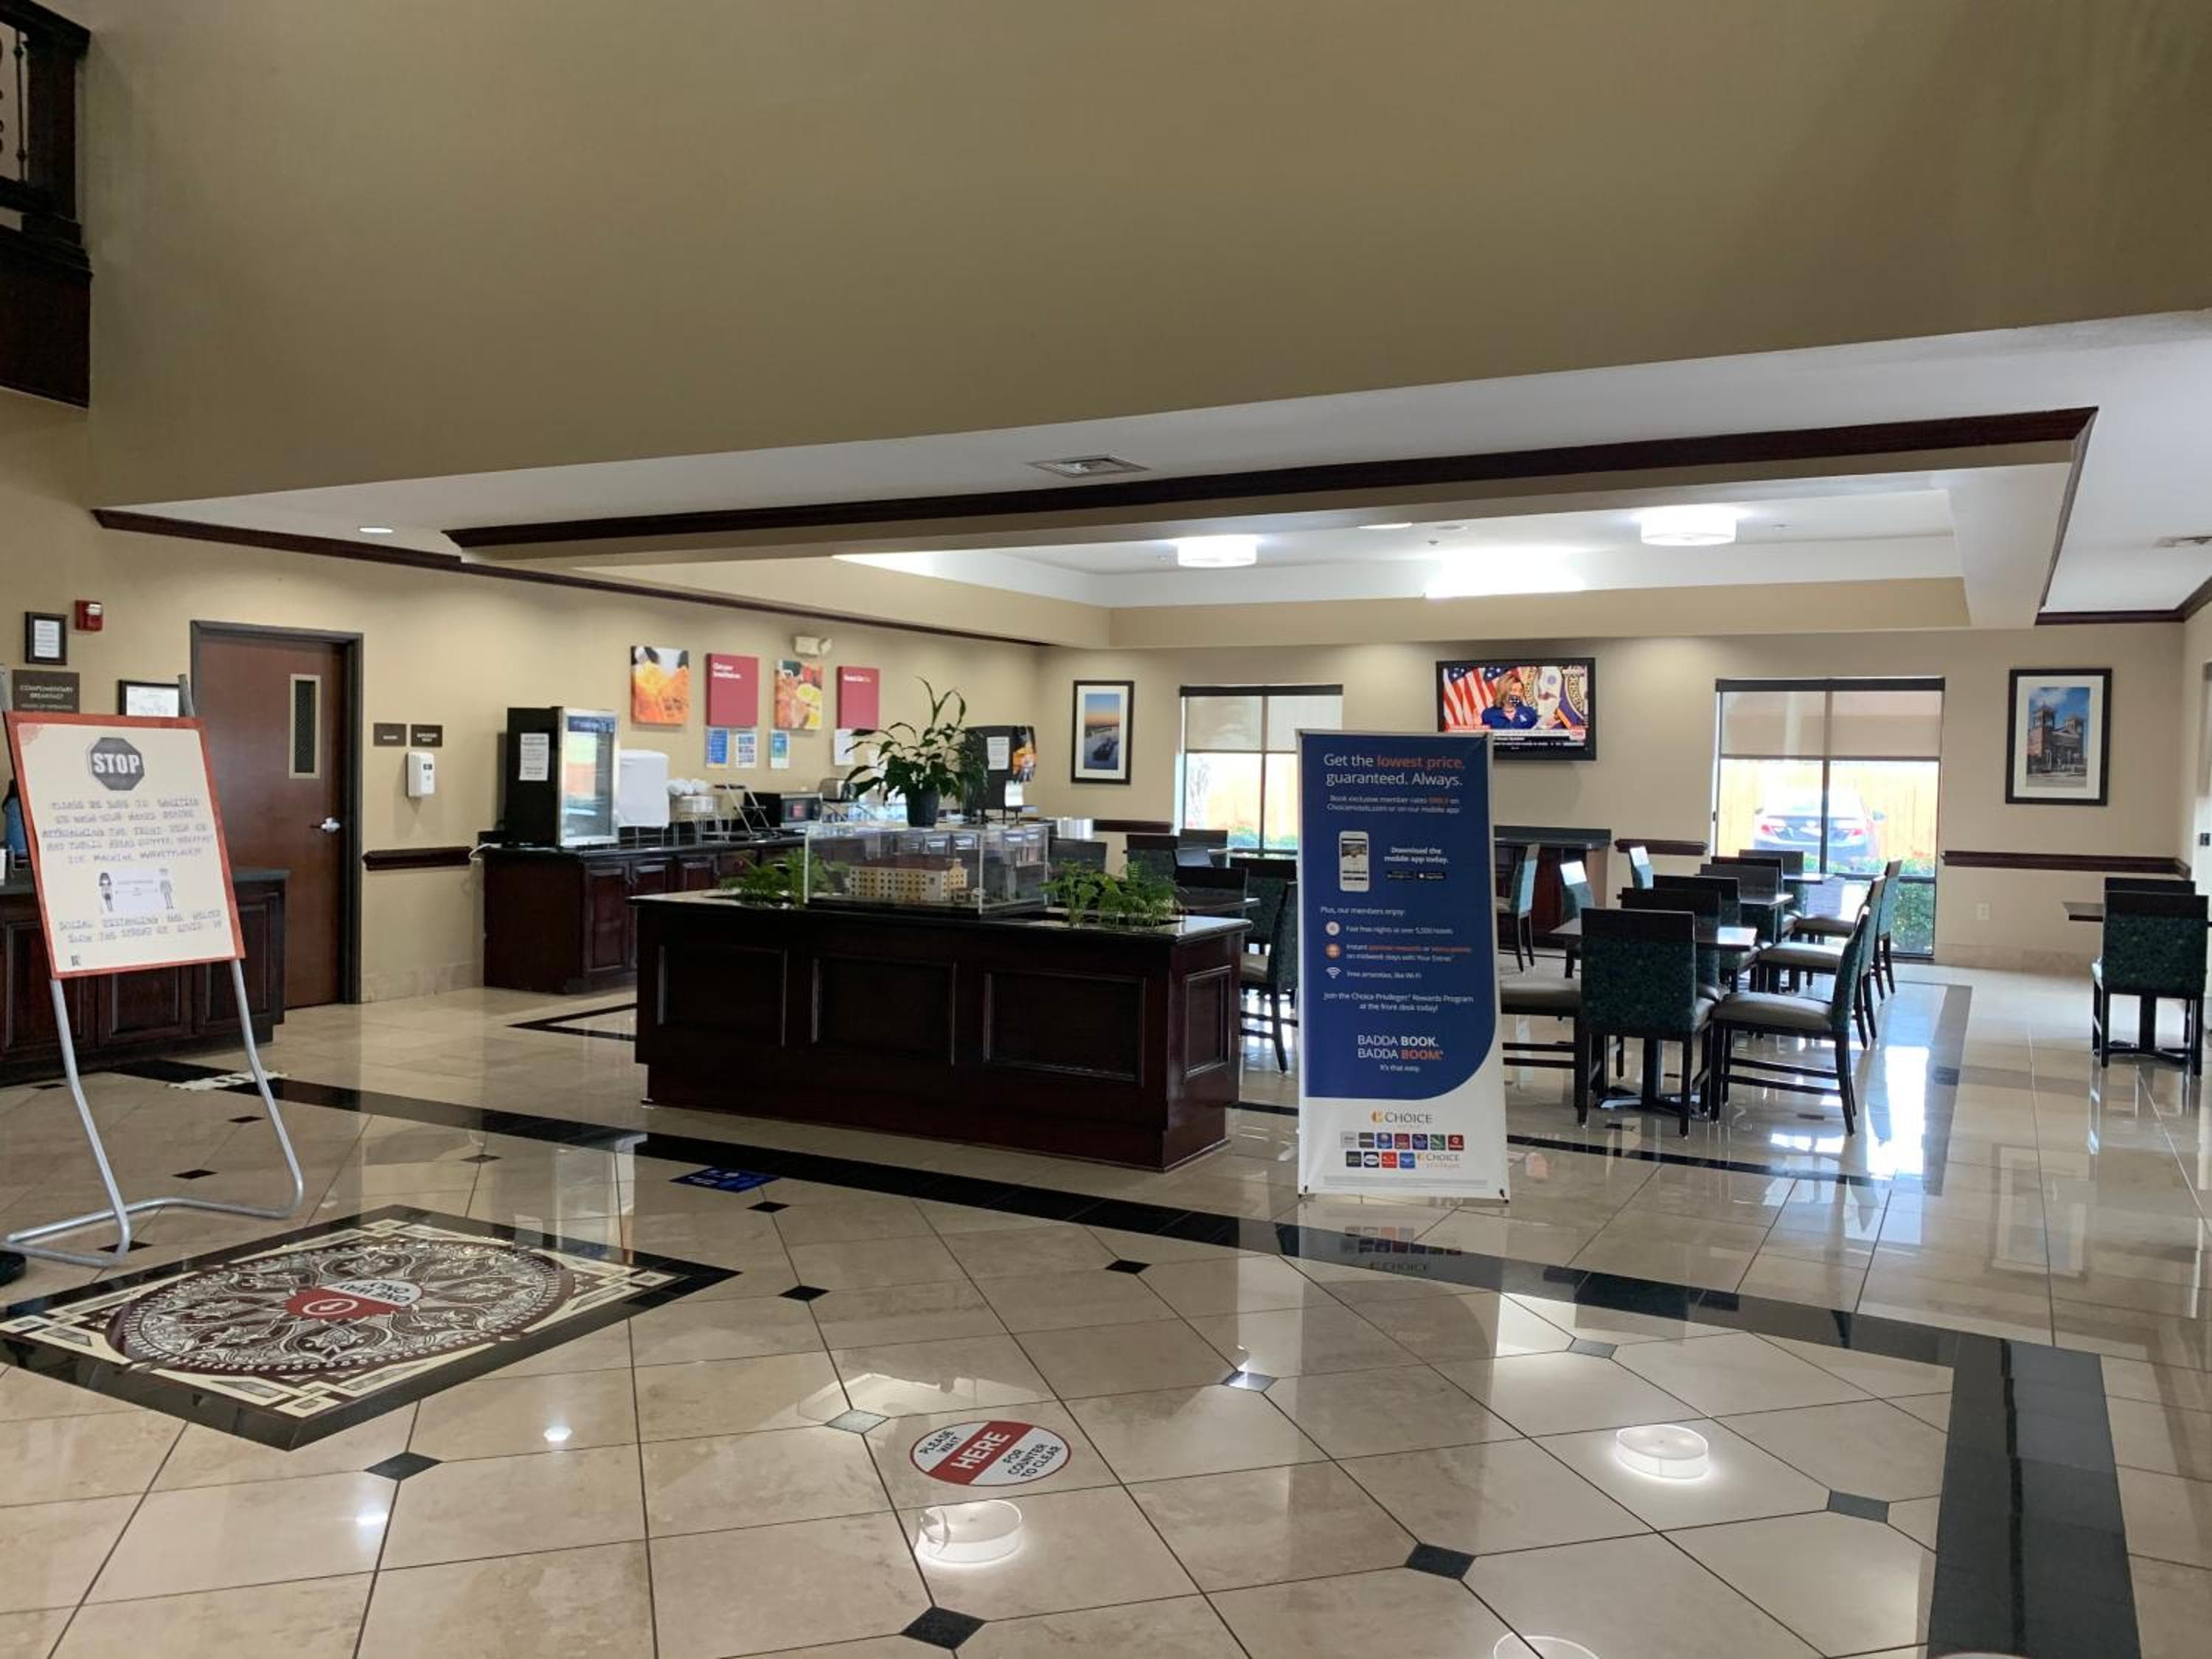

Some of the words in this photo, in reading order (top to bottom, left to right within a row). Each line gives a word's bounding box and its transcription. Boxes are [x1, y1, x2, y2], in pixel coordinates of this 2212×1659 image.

[93, 753, 141, 774] STOP
[1324, 754, 1349, 767] Get
[1352, 755, 1374, 768] the
[1377, 756, 1424, 768] lowest
[1326, 773, 1408, 787] guaranteed.
[1411, 773, 1464, 789] Always.
[1390, 846, 1428, 855] Download
[1429, 846, 1441, 855] the
[1426, 856, 1449, 864] today.
[1321, 906, 1337, 914] Plus,
[1324, 992, 1338, 1001] Join
[1351, 992, 1374, 1001] Choice
[1443, 995, 1474, 1004] Program
[1357, 1034, 1399, 1046] BADDA
[1401, 1036, 1439, 1047] BOOK.
[1357, 1048, 1399, 1060] BADDA
[1385, 1112, 1433, 1124] CHOICE
[1426, 1153, 1461, 1161] CHOICE
[919, 1430, 955, 1455] PLEASE
[936, 1436, 963, 1453] WAIT
[951, 1431, 1011, 1470] HERE
[1003, 1449, 1026, 1464] FOR
[1007, 1443, 1048, 1475] COUNTER
[1020, 1467, 1038, 1478] TO
[1033, 1445, 1062, 1470] CLEAR
